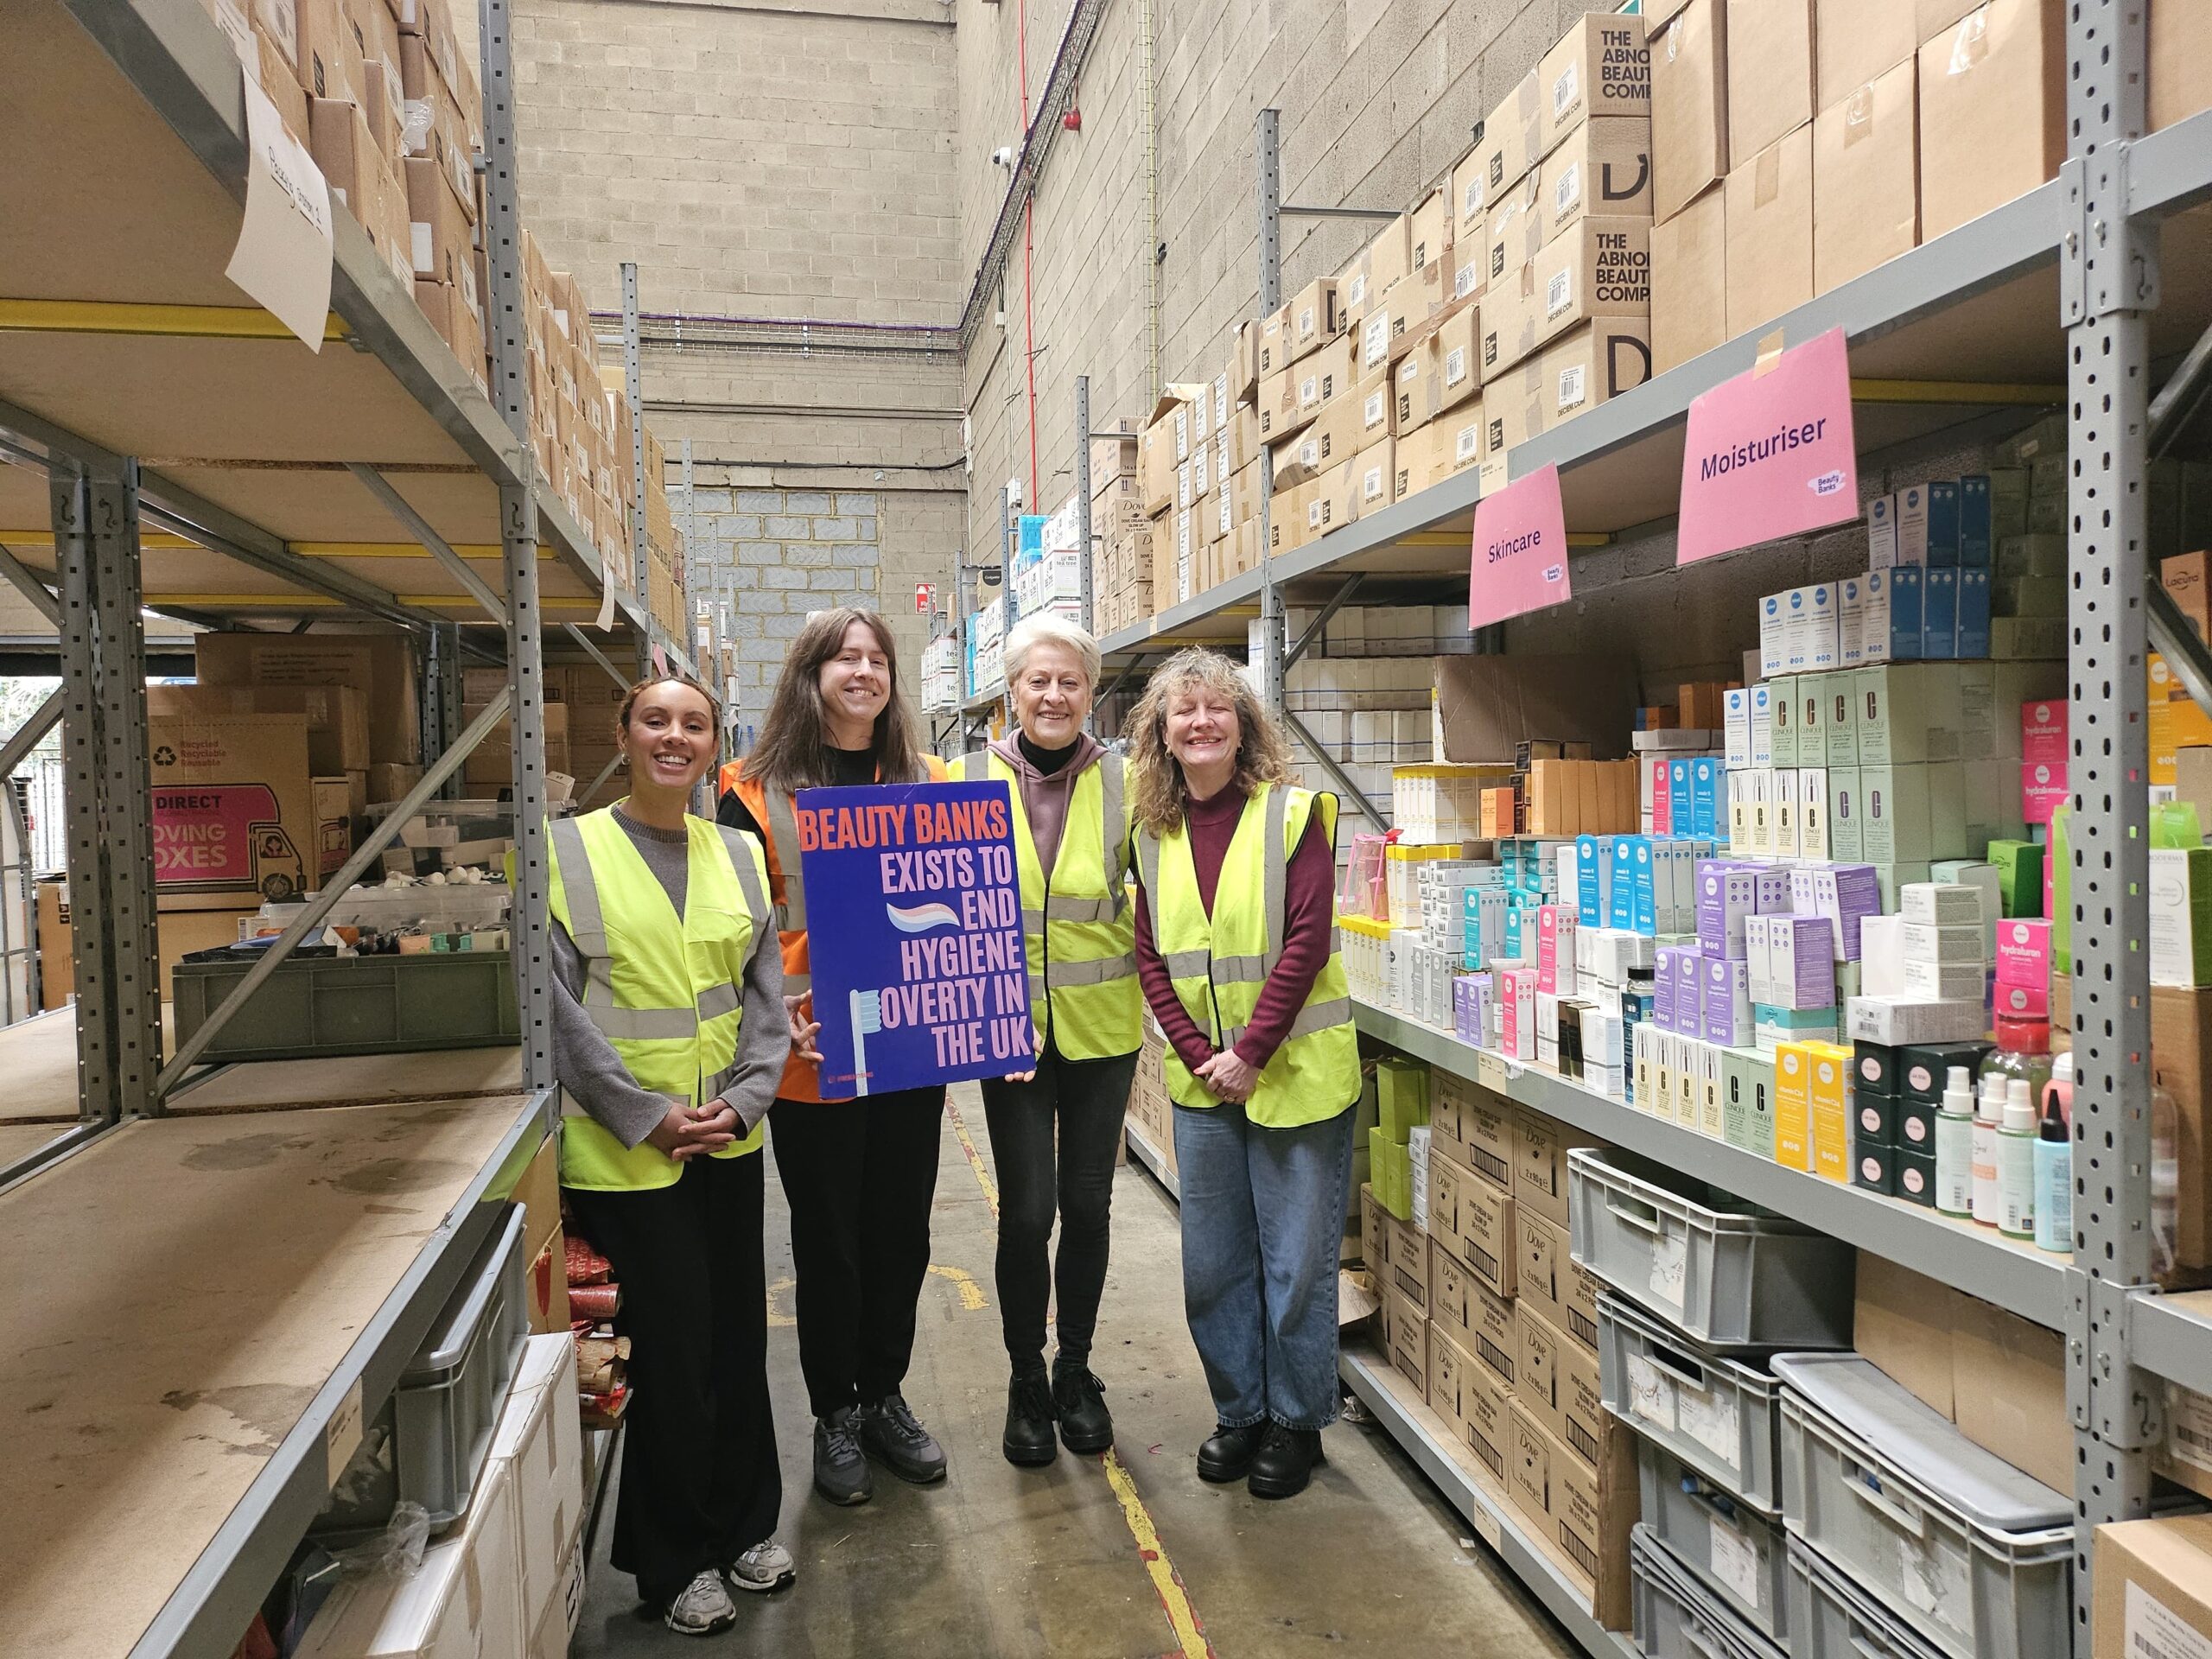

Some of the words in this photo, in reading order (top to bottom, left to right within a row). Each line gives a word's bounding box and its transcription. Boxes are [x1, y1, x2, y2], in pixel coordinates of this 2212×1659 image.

[1601, 31, 1631, 46] THE
[1555, 99, 1582, 128] DECIEM.COM
[1555, 201, 1580, 227] DECIEM.COM
[1597, 234, 1626, 249] THE
[1548, 299, 1573, 324] DECIEM.COM
[1557, 397, 1585, 417] DECIEM.COM
[1701, 418, 1826, 482] Moisturiser
[1818, 475, 1839, 486] Beauty
[1818, 483, 1836, 494] Banks
[1488, 530, 1541, 563] Skincare
[2025, 726, 2061, 737] hydraluron
[156, 796, 222, 809] DIRECT
[798, 804, 906, 851] BEAUTY
[914, 800, 1007, 844] BANKS
[880, 848, 975, 893] EXISTS
[978, 845, 1012, 886] TO
[961, 888, 1017, 931] END
[900, 930, 1022, 982] HYGIENE
[2000, 944, 2041, 956] hydraluron
[994, 973, 1025, 1015] IN
[931, 1024, 985, 1068] THE
[990, 1015, 1031, 1059] UK
[1725, 1103, 1745, 1115] CLINIQUE
[1751, 1111, 1772, 1122] CLINIQUE
[1526, 1125, 1546, 1149] Dove
[1437, 1170, 1451, 1192] Dove
[1527, 1226, 1545, 1252] Dove
[1442, 1261, 1459, 1284] Dove
[1571, 1264, 1581, 1277] DOVE
[1529, 1329, 1546, 1358] Dove
[1438, 1347, 1454, 1372] Dove
[1520, 1429, 1538, 1460] Dove
